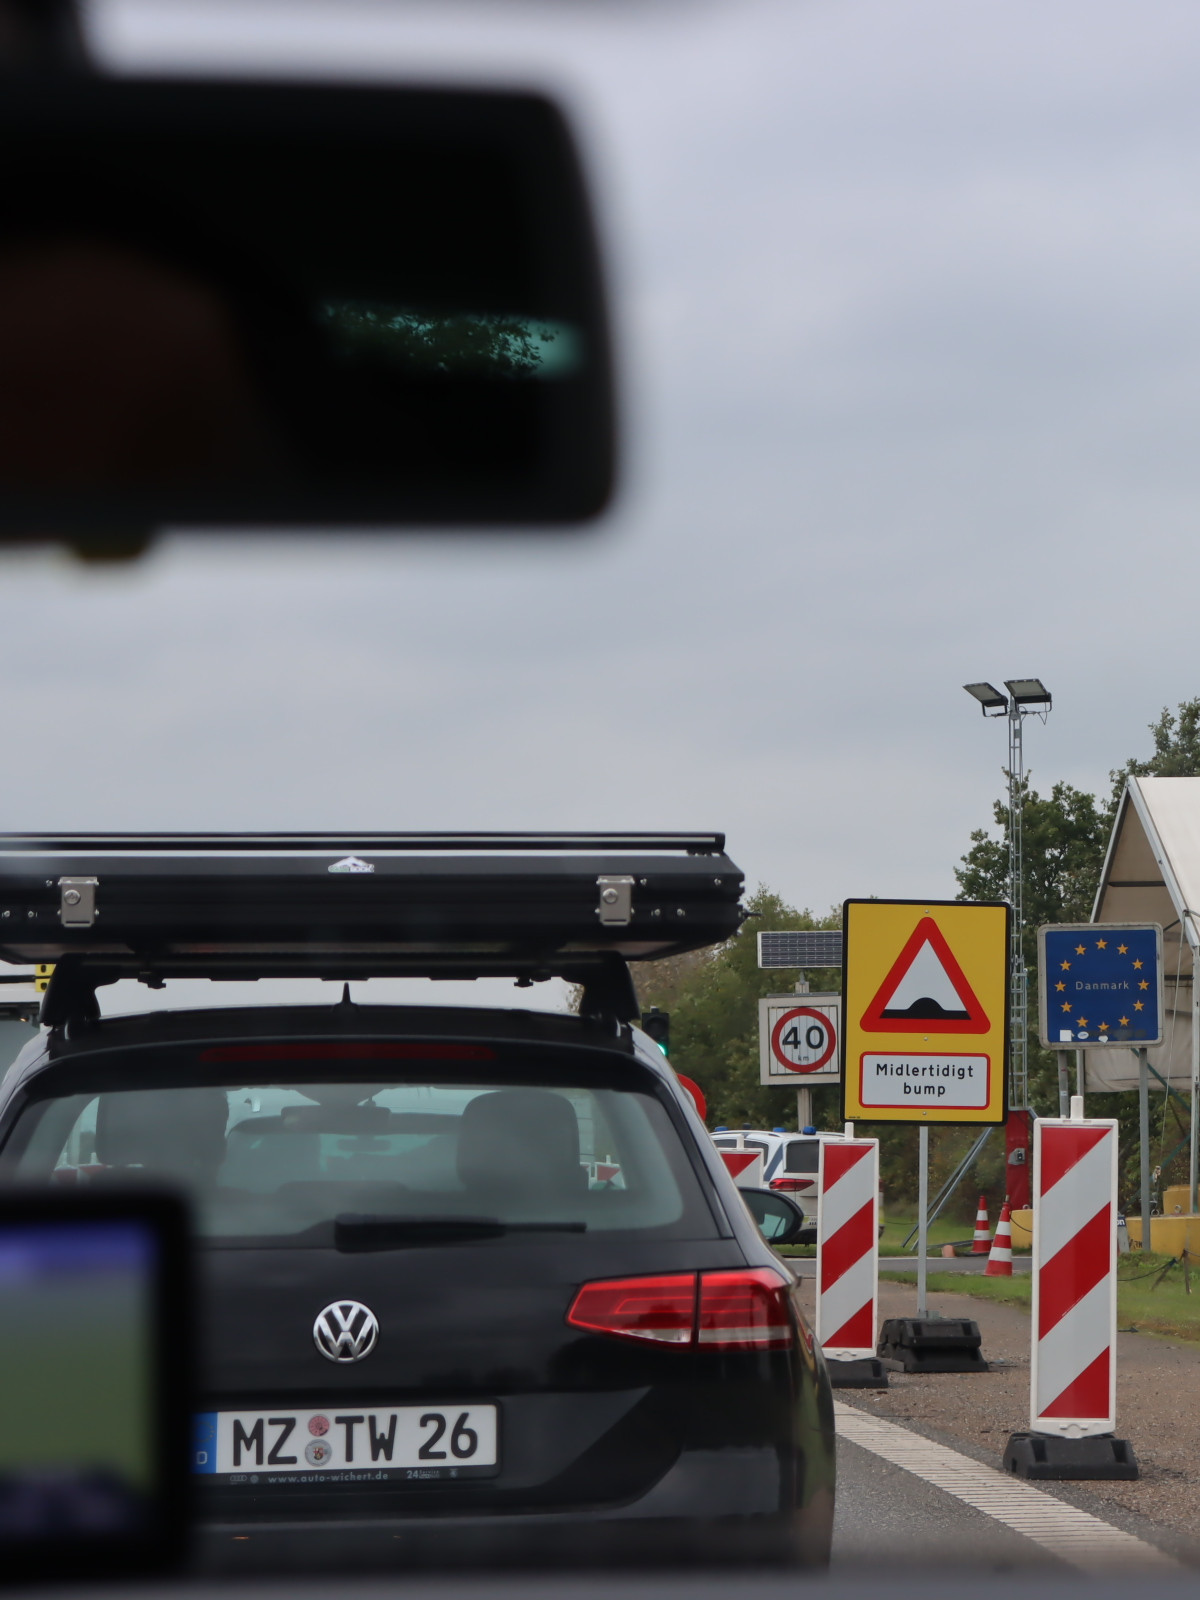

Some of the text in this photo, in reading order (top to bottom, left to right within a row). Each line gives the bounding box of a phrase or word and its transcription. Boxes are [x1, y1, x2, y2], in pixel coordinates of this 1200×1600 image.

[1075, 980, 1130, 991] Danmark
[782, 1025, 825, 1050] 40
[797, 1054, 810, 1062] km
[876, 1062, 974, 1081] Midlertidigt
[903, 1082, 946, 1097] bump
[232, 1417, 297, 1467] MZ
[335, 1413, 398, 1463] TW
[417, 1412, 478, 1460] 26
[196, 1451, 208, 1465] D
[267, 1470, 389, 1484] www.auto-wichert.de
